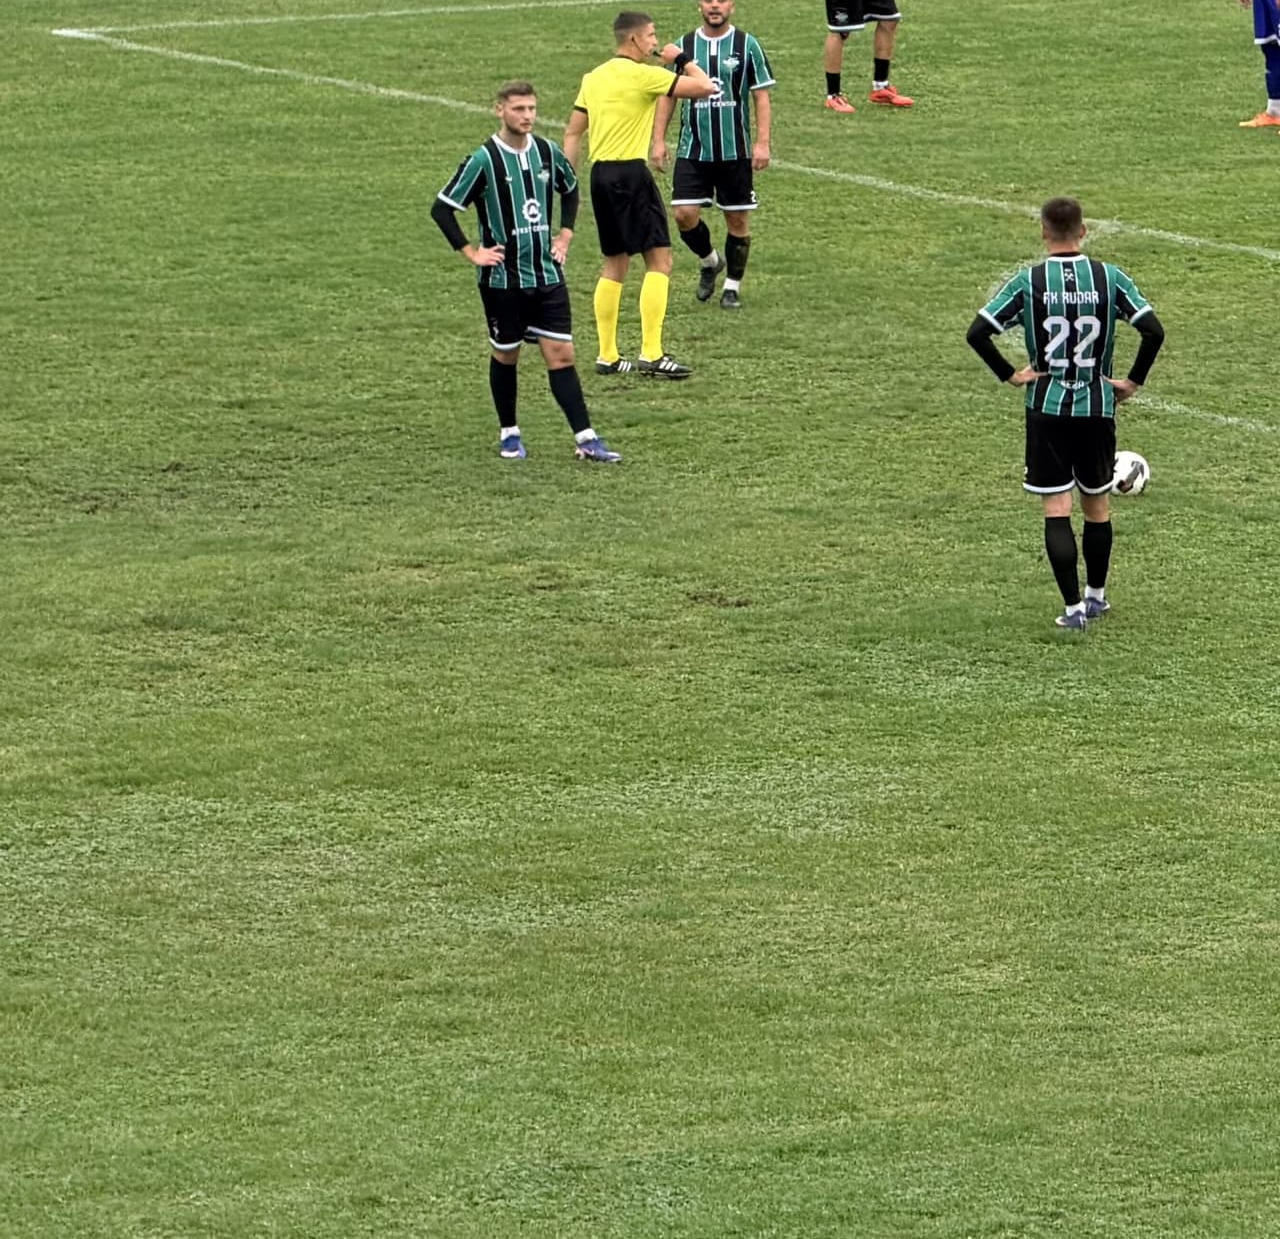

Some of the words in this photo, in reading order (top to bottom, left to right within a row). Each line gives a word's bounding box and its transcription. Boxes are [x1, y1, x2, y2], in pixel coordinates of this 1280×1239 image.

[1043, 291, 1058, 305] FK
[1062, 290, 1100, 305] RUDAR
[1042, 315, 1102, 368] 22
